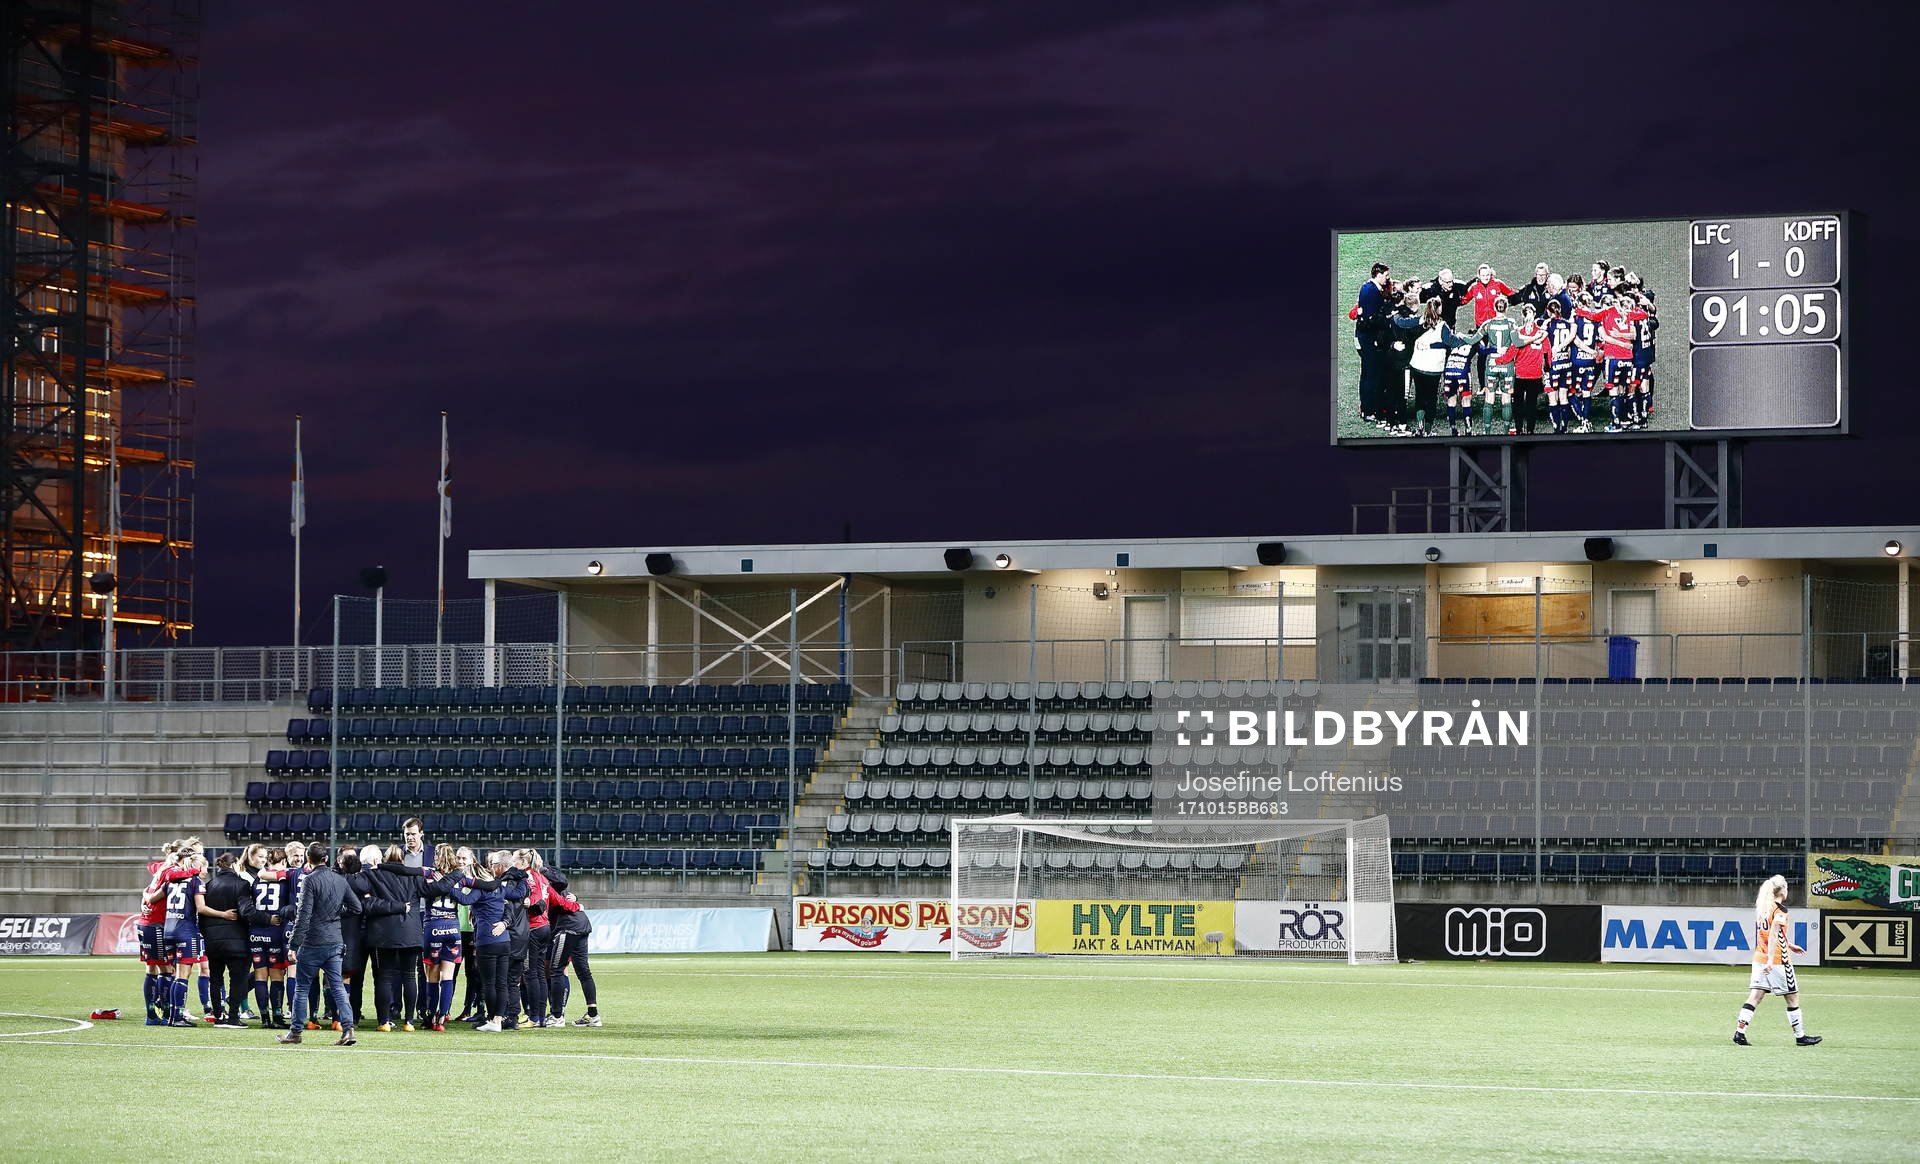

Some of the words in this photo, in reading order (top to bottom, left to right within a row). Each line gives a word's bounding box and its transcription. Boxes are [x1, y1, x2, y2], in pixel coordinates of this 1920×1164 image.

[1693, 224, 1731, 245] LFC
[1784, 220, 1837, 242] KDFF
[1727, 249, 1740, 279] 1
[1784, 246, 1805, 278] 0
[1702, 293, 1826, 338] 91:05
[167, 882, 188, 910] 25
[256, 883, 280, 911] 23
[0, 917, 71, 938] SELECT
[797, 900, 912, 929] PÄRSONS
[917, 901, 1032, 930] PÄRSONS
[1072, 904, 1196, 936] HYLTE
[1279, 903, 1345, 941] RÖR
[1073, 939, 1105, 950] JAKT
[1110, 939, 1120, 950] &
[1126, 939, 1196, 951] LANTMAN
[1278, 940, 1347, 950] PRODUKTION
[1603, 918, 1808, 951] MATAI
[1831, 922, 1905, 955] XL
